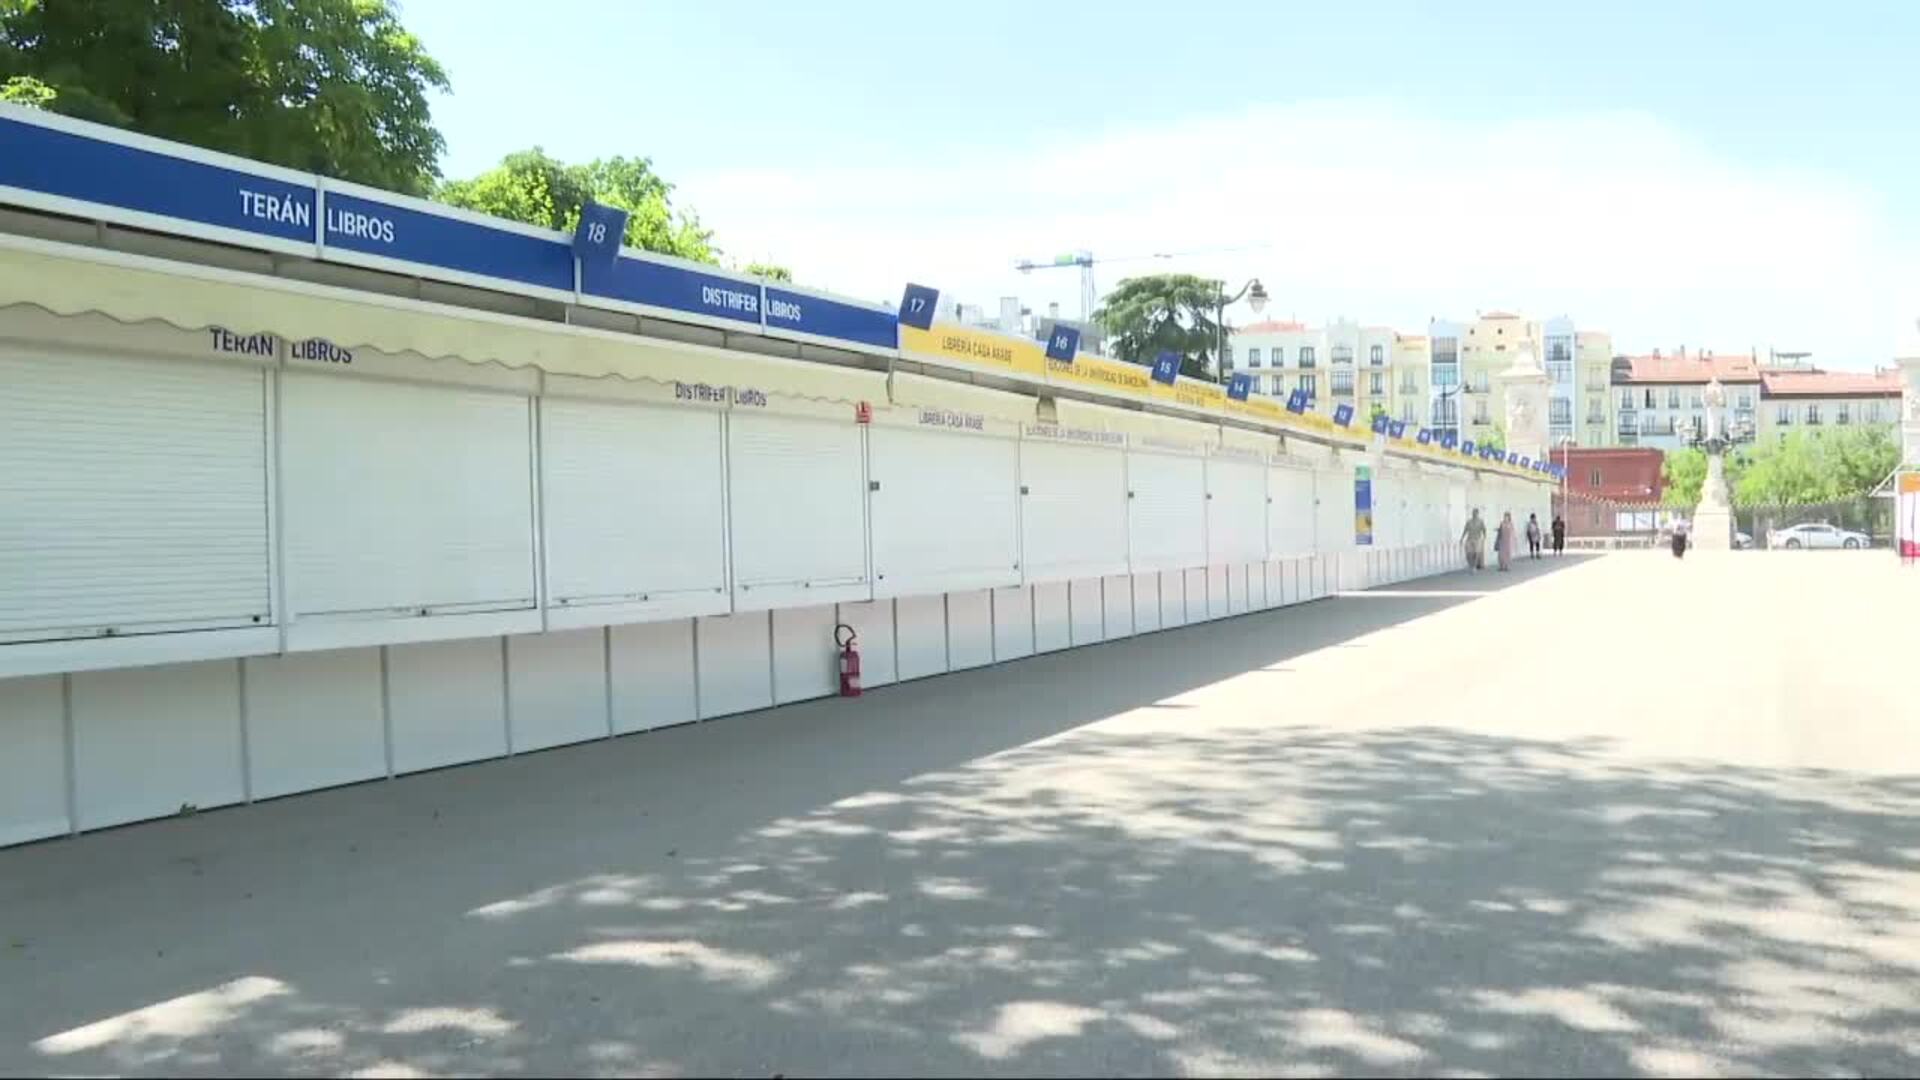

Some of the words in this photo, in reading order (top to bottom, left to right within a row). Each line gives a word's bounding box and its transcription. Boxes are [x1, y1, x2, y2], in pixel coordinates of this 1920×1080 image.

[239, 189, 310, 228] TERÁN
[327, 207, 395, 244] LIBROS
[587, 222, 606, 244] 18
[702, 286, 759, 313] DISTRIFER
[766, 299, 802, 322] LIBROS
[910, 298, 926, 313] 17
[291, 337, 353, 364] LIBROS
[1055, 335, 1069, 350] 16
[1159, 361, 1172, 374] 15
[734, 387, 768, 407] LIBROS
[1233, 382, 1245, 393] 14
